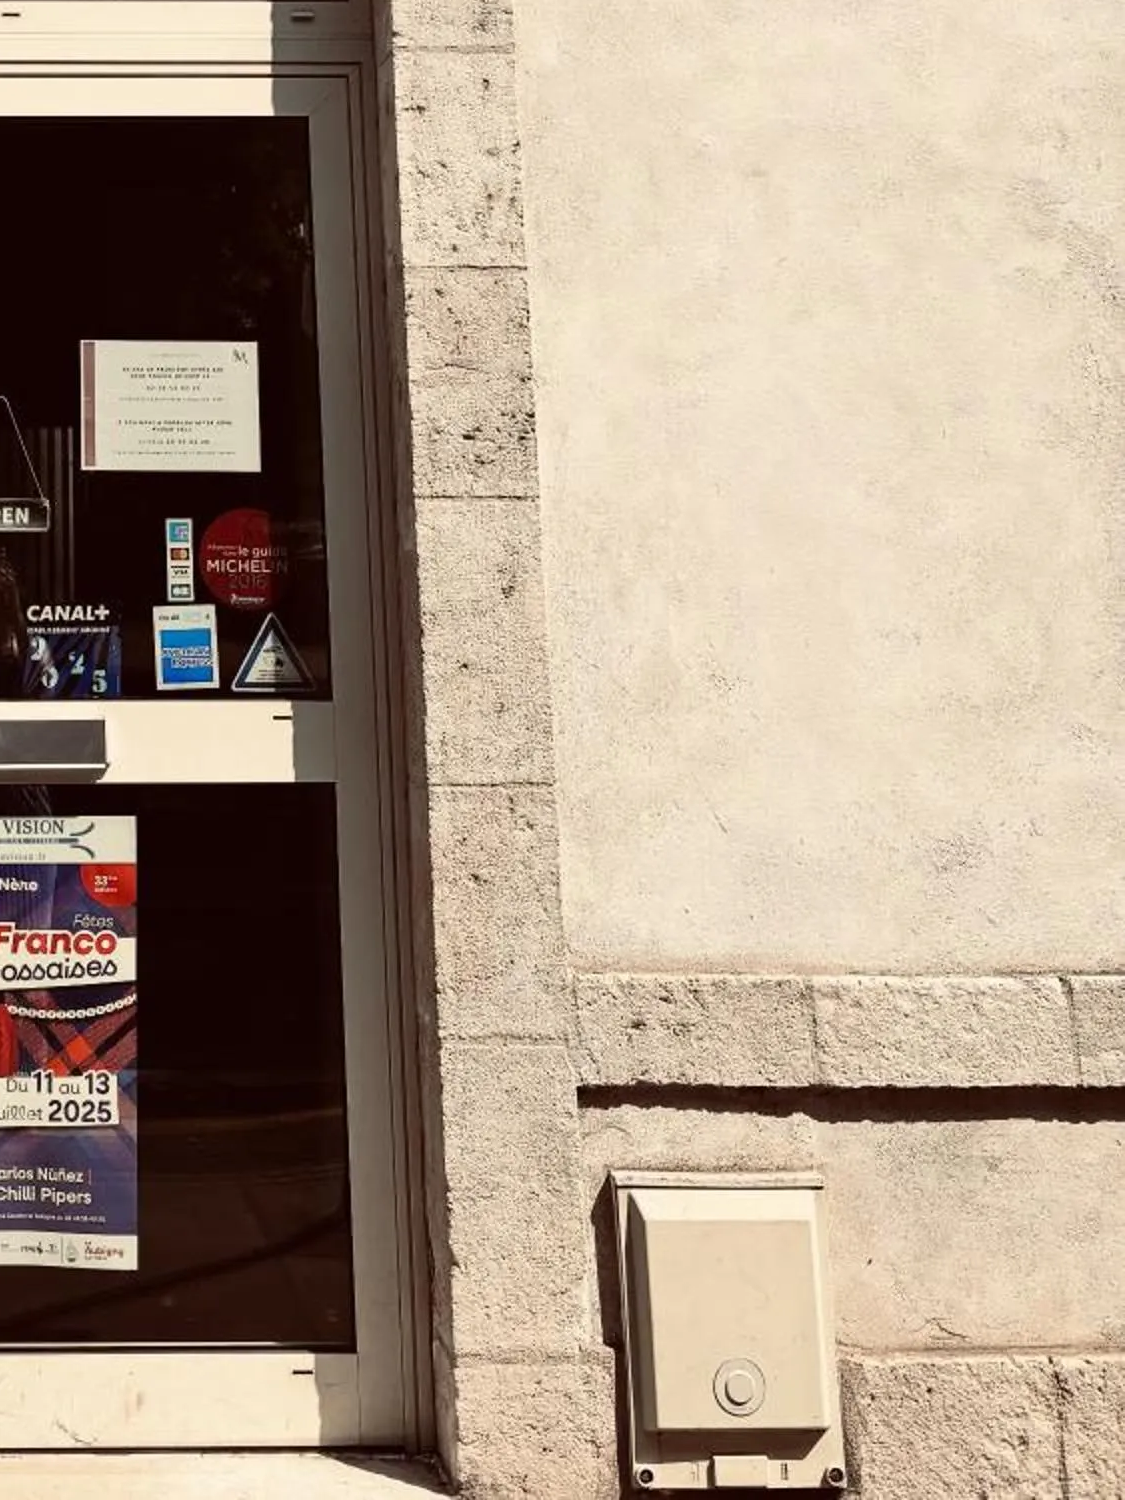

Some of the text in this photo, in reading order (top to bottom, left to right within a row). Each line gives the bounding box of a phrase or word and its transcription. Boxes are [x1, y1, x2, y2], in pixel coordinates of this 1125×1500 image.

[27, 604, 110, 621] CANAL+
[2, 819, 65, 835] VISION
[74, 913, 114, 928] Fêtes
[6, 1070, 110, 1095] Du 11 au 13
[48, 1100, 112, 1123] 2025
[40, 1187, 92, 1206] Pipers
